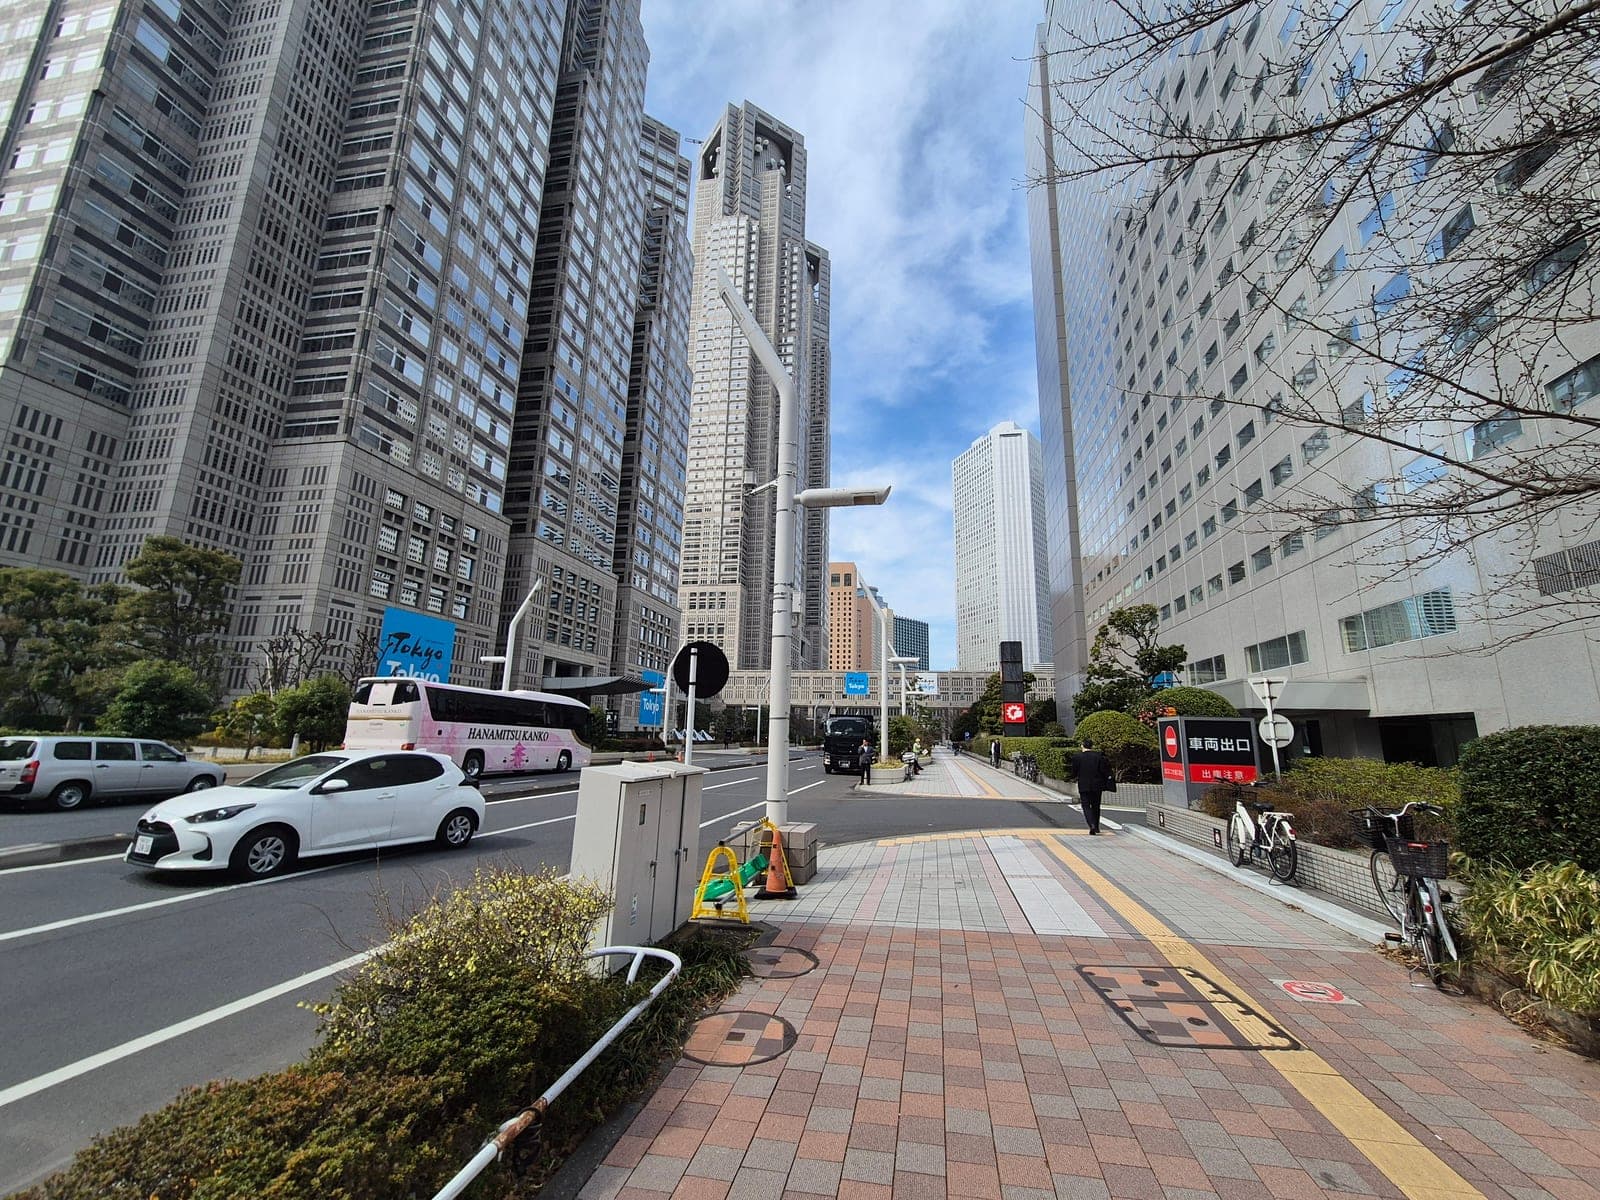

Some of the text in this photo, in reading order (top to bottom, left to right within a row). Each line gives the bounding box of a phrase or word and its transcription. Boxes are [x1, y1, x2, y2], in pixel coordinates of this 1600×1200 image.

[391, 632, 443, 670] Tokyo
[643, 698, 660, 714] Tokyo
[468, 728, 549, 741] HANAMITSU KANKO
[1188, 737, 1251, 752] 車両出口
